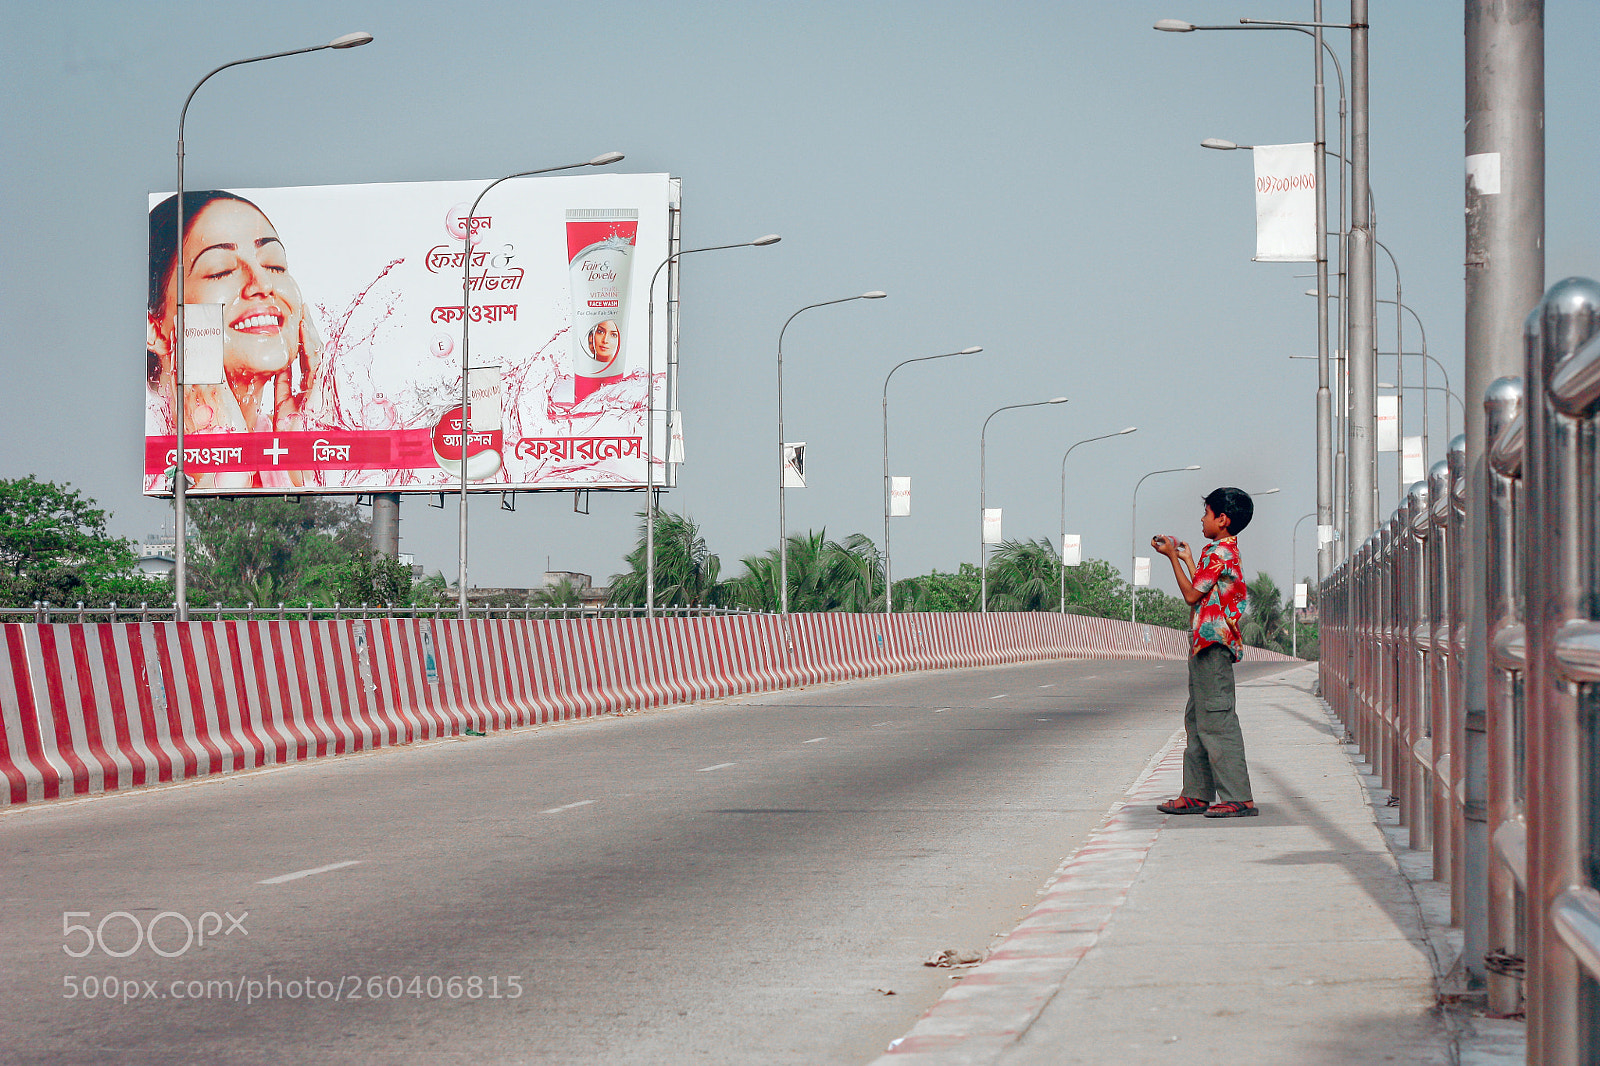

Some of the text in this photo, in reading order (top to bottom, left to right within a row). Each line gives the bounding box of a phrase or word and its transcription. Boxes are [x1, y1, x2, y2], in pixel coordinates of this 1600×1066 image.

[1256, 172, 1316, 195] 01970010100
[457, 216, 493, 235] নতুন
[581, 260, 601, 271] Fair
[587, 270, 617, 283] Lovely
[438, 341, 445, 351] E
[312, 439, 351, 462] ক্রিম
[514, 436, 643, 462] ফেয়ারনেস
